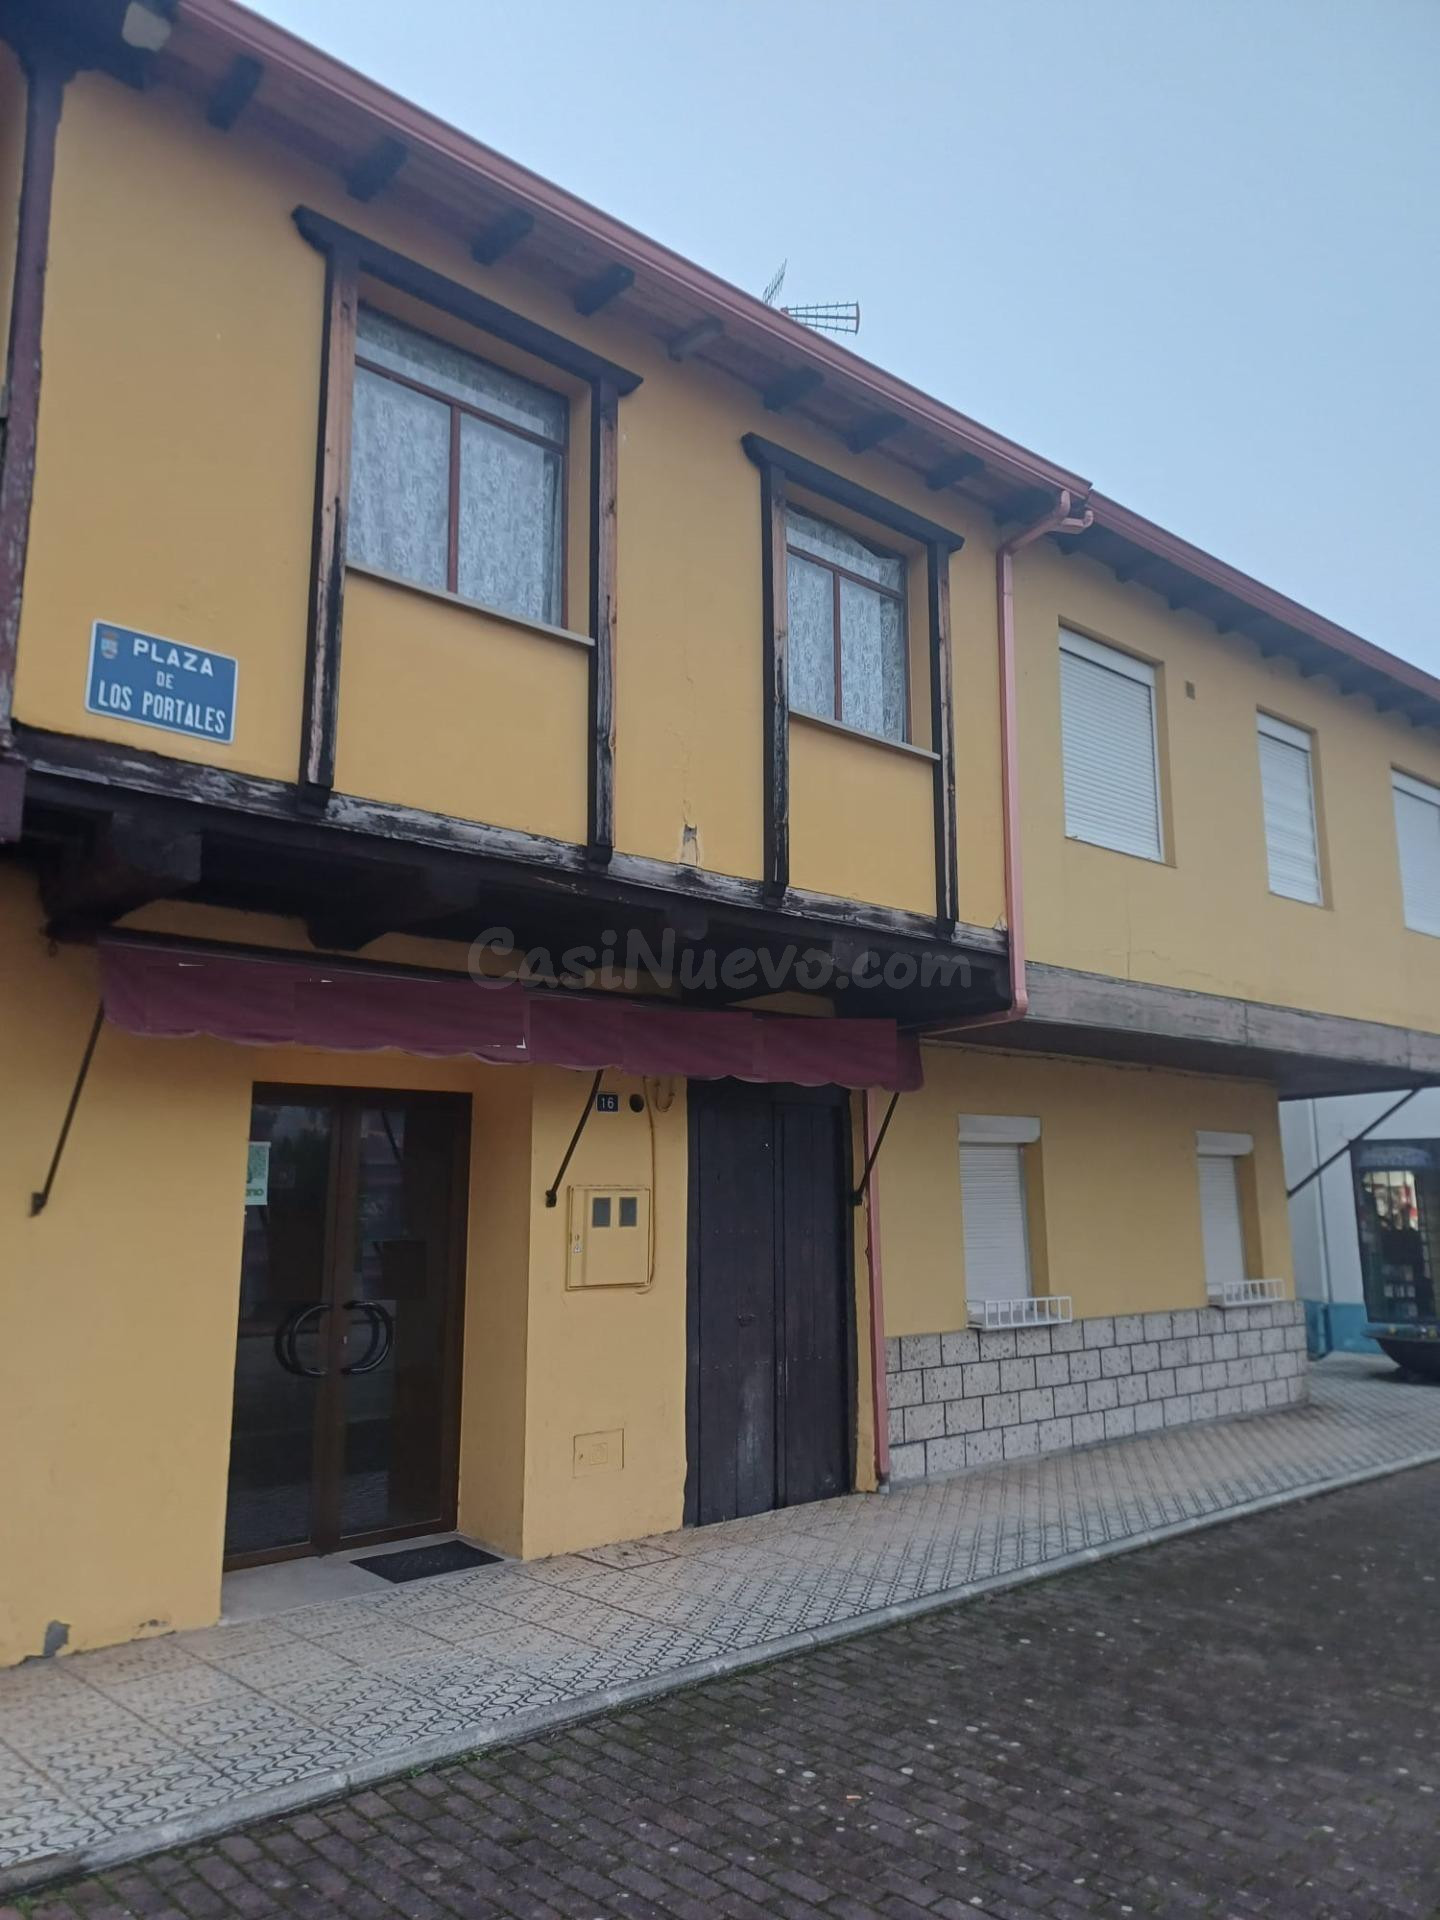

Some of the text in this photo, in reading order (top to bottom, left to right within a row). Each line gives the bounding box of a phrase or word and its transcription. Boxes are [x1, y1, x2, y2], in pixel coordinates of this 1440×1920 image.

[133, 638, 213, 677] PLAZA
[156, 671, 174, 689] DE
[98, 680, 226, 734] LOS PORTALES
[601, 1096, 614, 1110] 16
